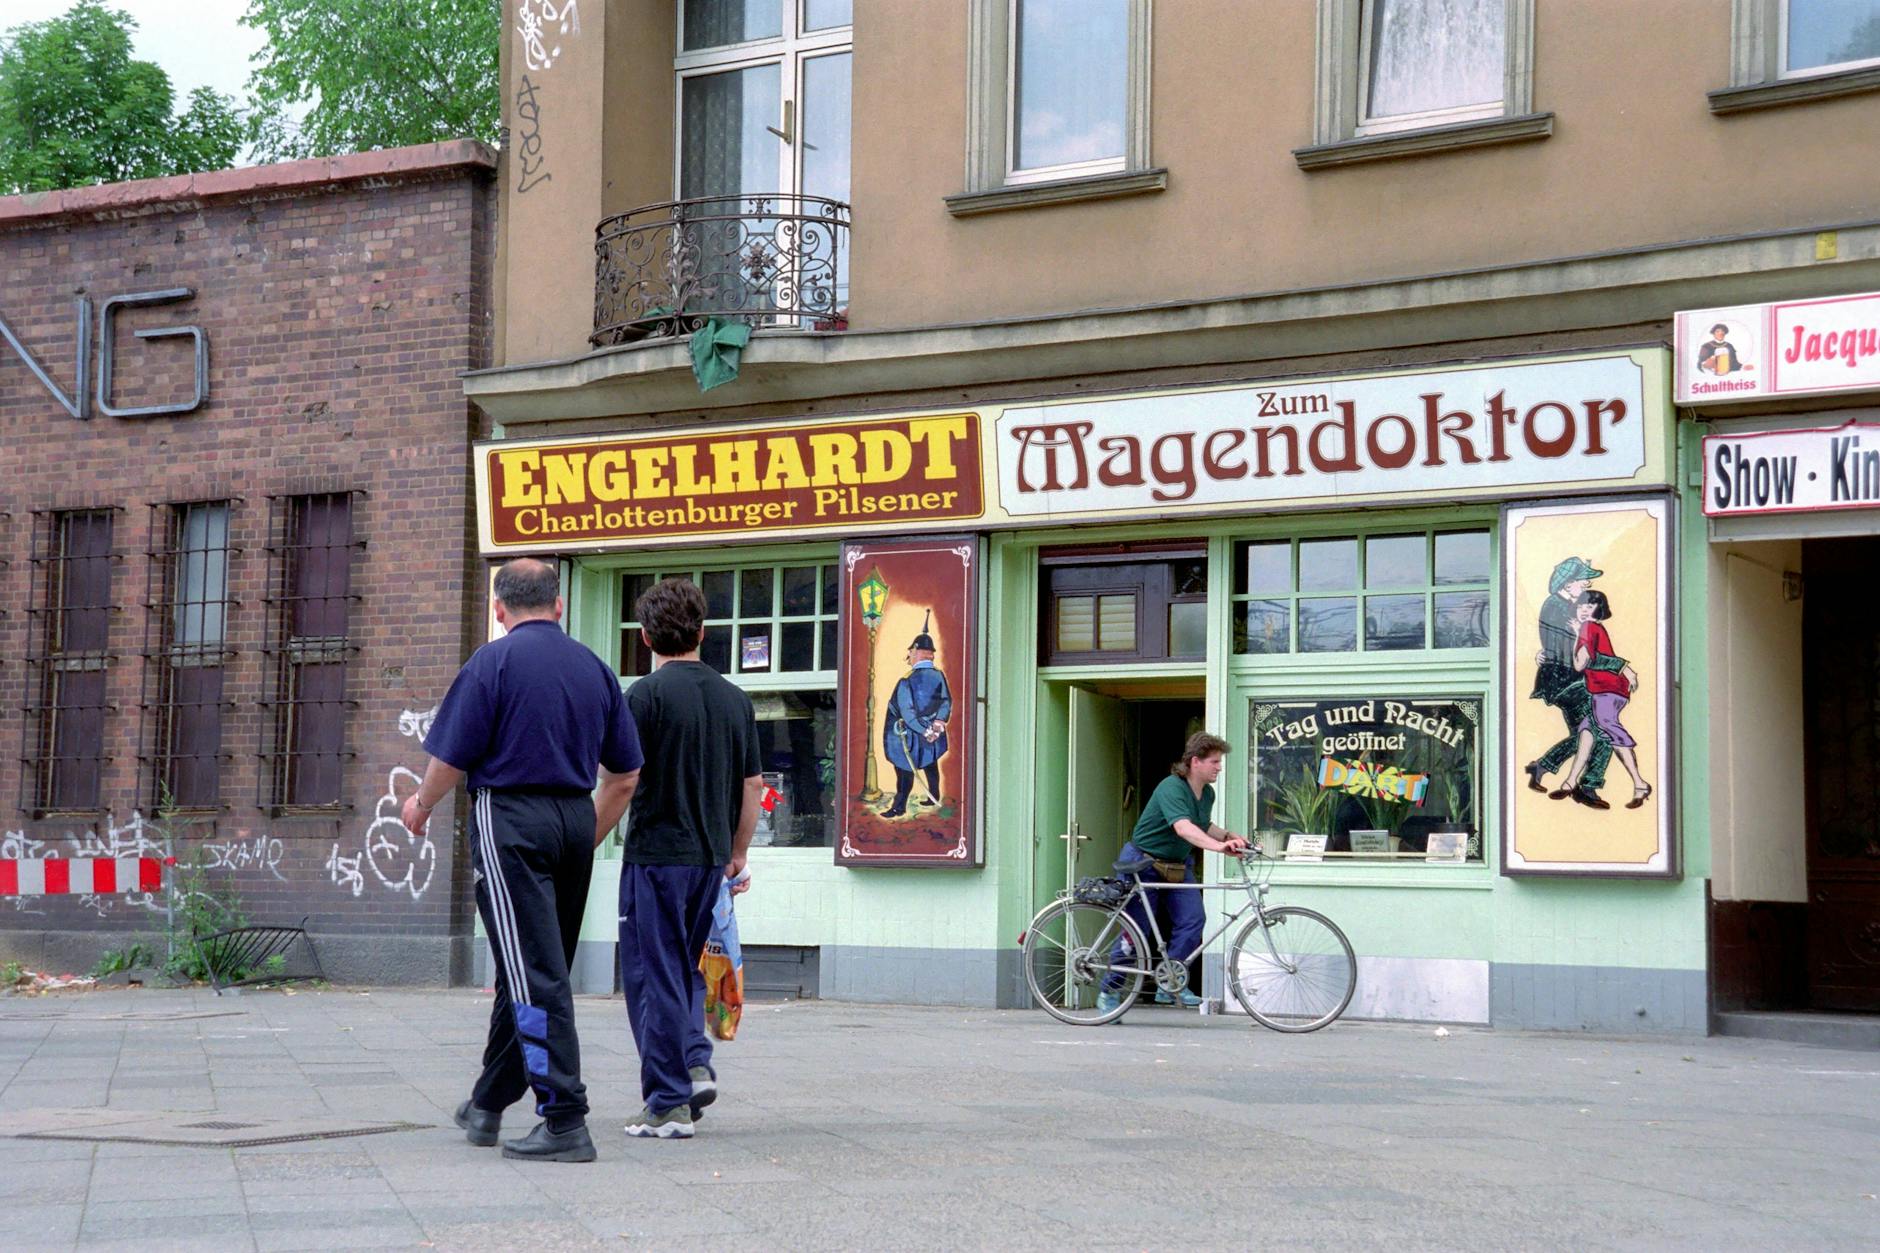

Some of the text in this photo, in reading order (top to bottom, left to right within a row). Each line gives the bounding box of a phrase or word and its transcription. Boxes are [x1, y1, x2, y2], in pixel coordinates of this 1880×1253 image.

[1785, 325, 1880, 367] Jacqu
[1256, 391, 1329, 418] Zum
[1691, 379, 1756, 394] Schultheiss
[499, 417, 967, 508] ENGELHARDT
[1010, 388, 1628, 501] Magendoktor
[1714, 443, 1797, 509] Show
[1830, 434, 1880, 502] Kin
[514, 488, 958, 536] Charlottenburger Pilsener
[1266, 701, 1465, 748] Tag und Nacht
[1322, 731, 1406, 754] geöffnet
[1324, 757, 1426, 802] DART
